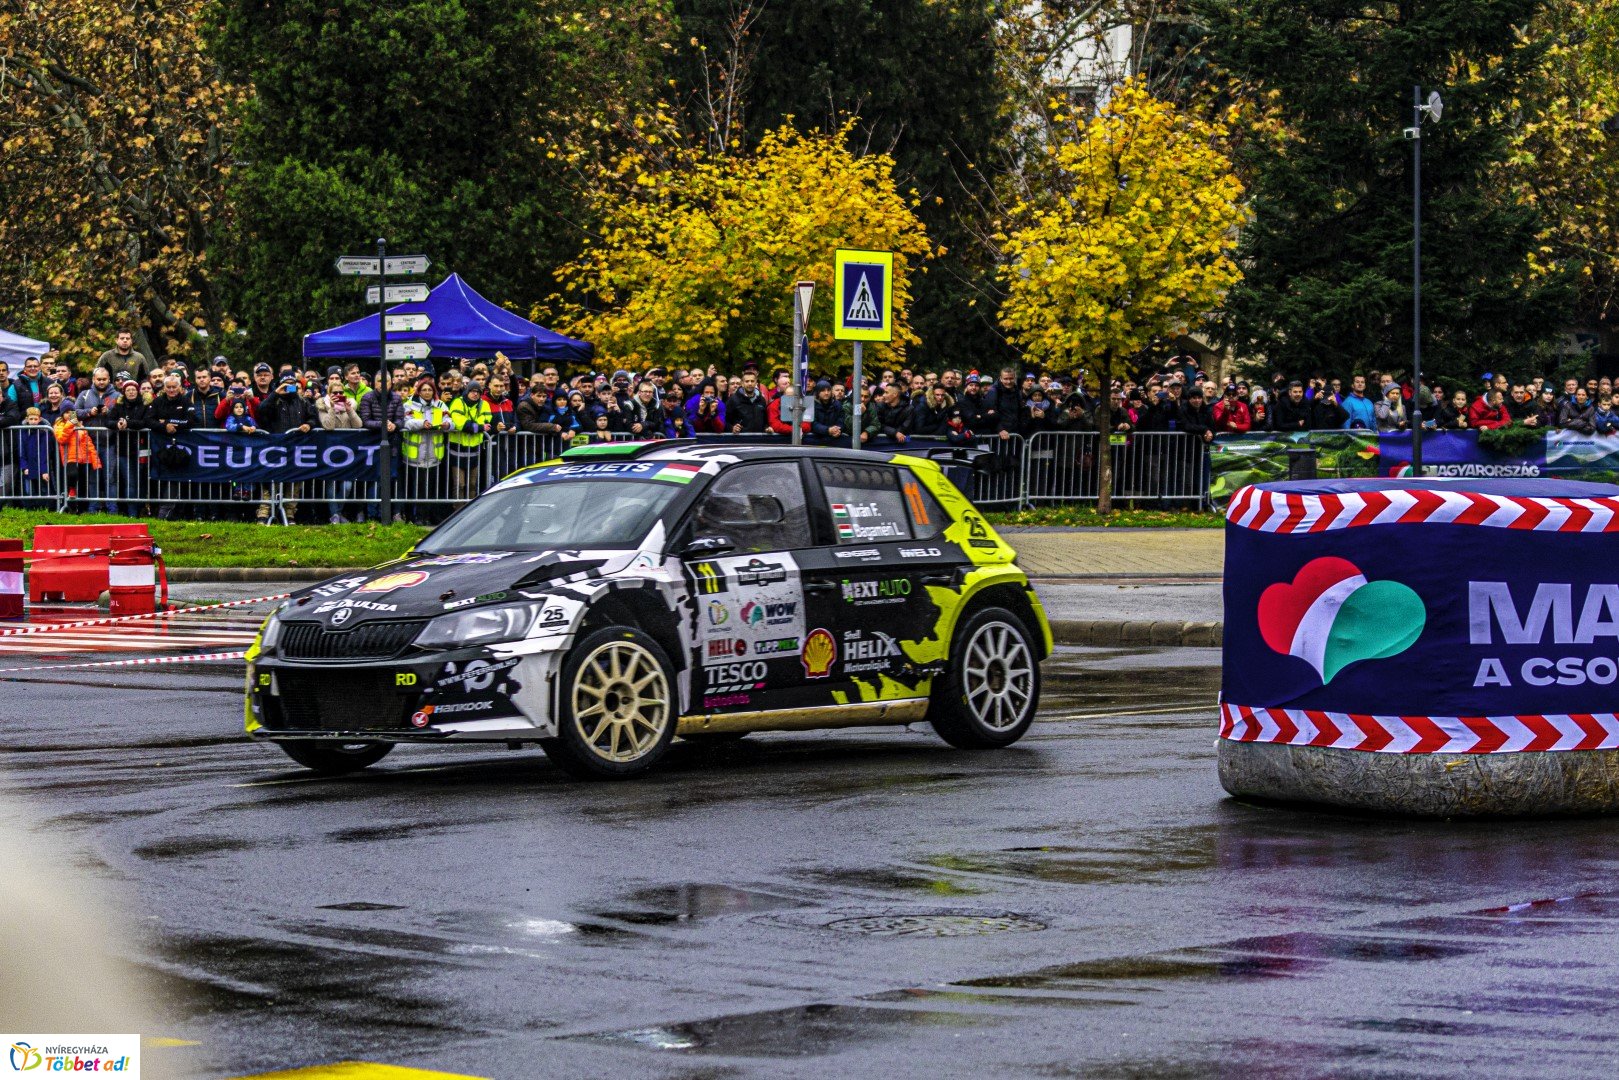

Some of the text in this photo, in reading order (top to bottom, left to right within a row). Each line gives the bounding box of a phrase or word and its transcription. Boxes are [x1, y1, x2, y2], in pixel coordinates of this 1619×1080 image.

[165, 445, 382, 469] EUGEOT
[547, 462, 653, 477] SEAJETS
[964, 516, 986, 537] 25
[697, 563, 718, 593] 11
[354, 602, 397, 611] ULTRA
[544, 609, 563, 621] 25
[765, 602, 796, 617] WOW
[708, 639, 731, 656] HELL
[844, 631, 901, 660] HELIX
[259, 674, 271, 685] RD
[396, 673, 417, 685] RD
[704, 662, 767, 684] TESCO
[1473, 657, 1619, 686] A CSO
